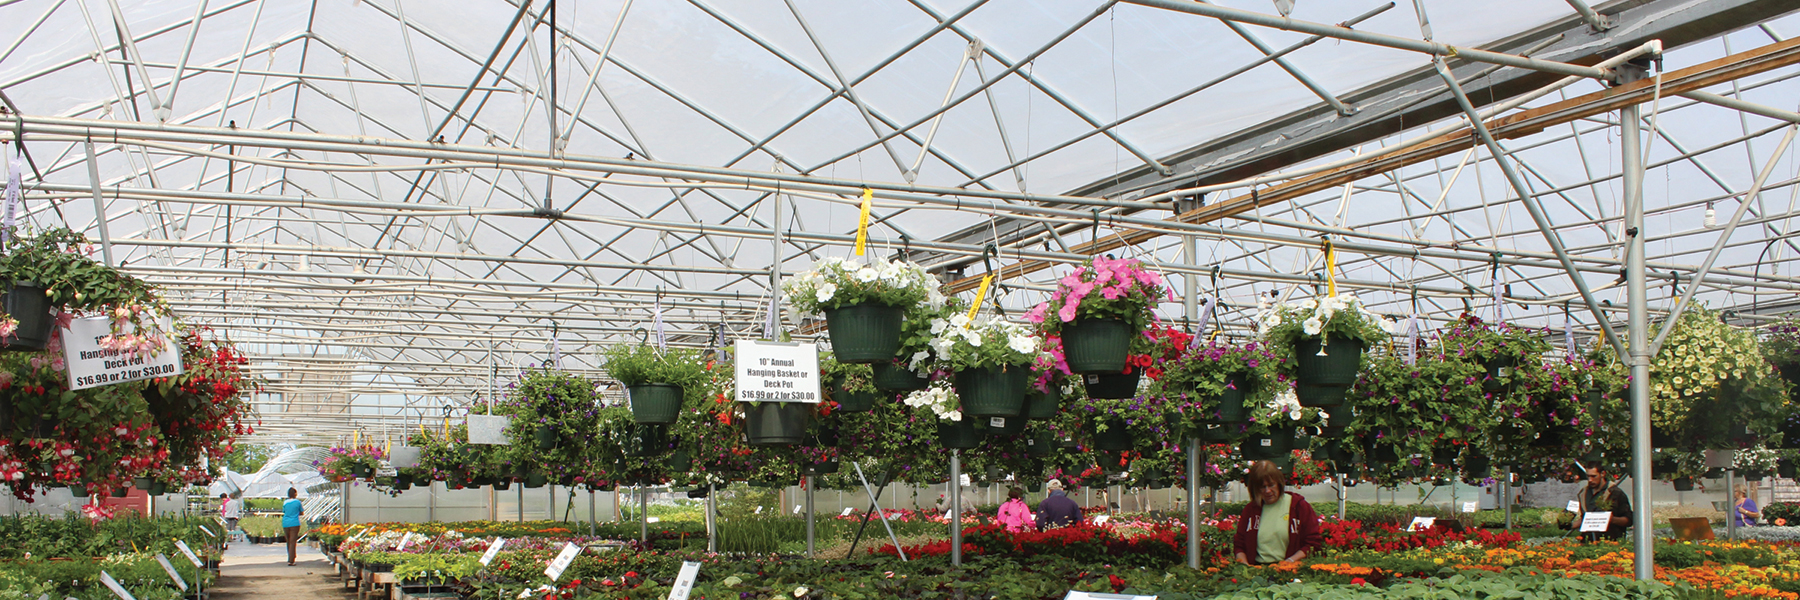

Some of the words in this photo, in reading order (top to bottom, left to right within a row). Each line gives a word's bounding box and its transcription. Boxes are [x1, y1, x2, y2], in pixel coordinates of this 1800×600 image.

[104, 359, 128, 370] Deck
[771, 358, 795, 367] Annual
[76, 373, 108, 387] $16.99
[110, 373, 120, 381] or
[121, 370, 128, 380] 2
[128, 369, 142, 379] for
[143, 363, 175, 377] $30.00
[747, 368, 775, 378] Hanging
[777, 369, 800, 378] Basket
[764, 379, 781, 388] Deck
[782, 380, 793, 388] Pot
[741, 389, 765, 399] $16.99
[775, 391, 780, 399] 2
[780, 391, 790, 399] for
[791, 391, 815, 400] $30.00
